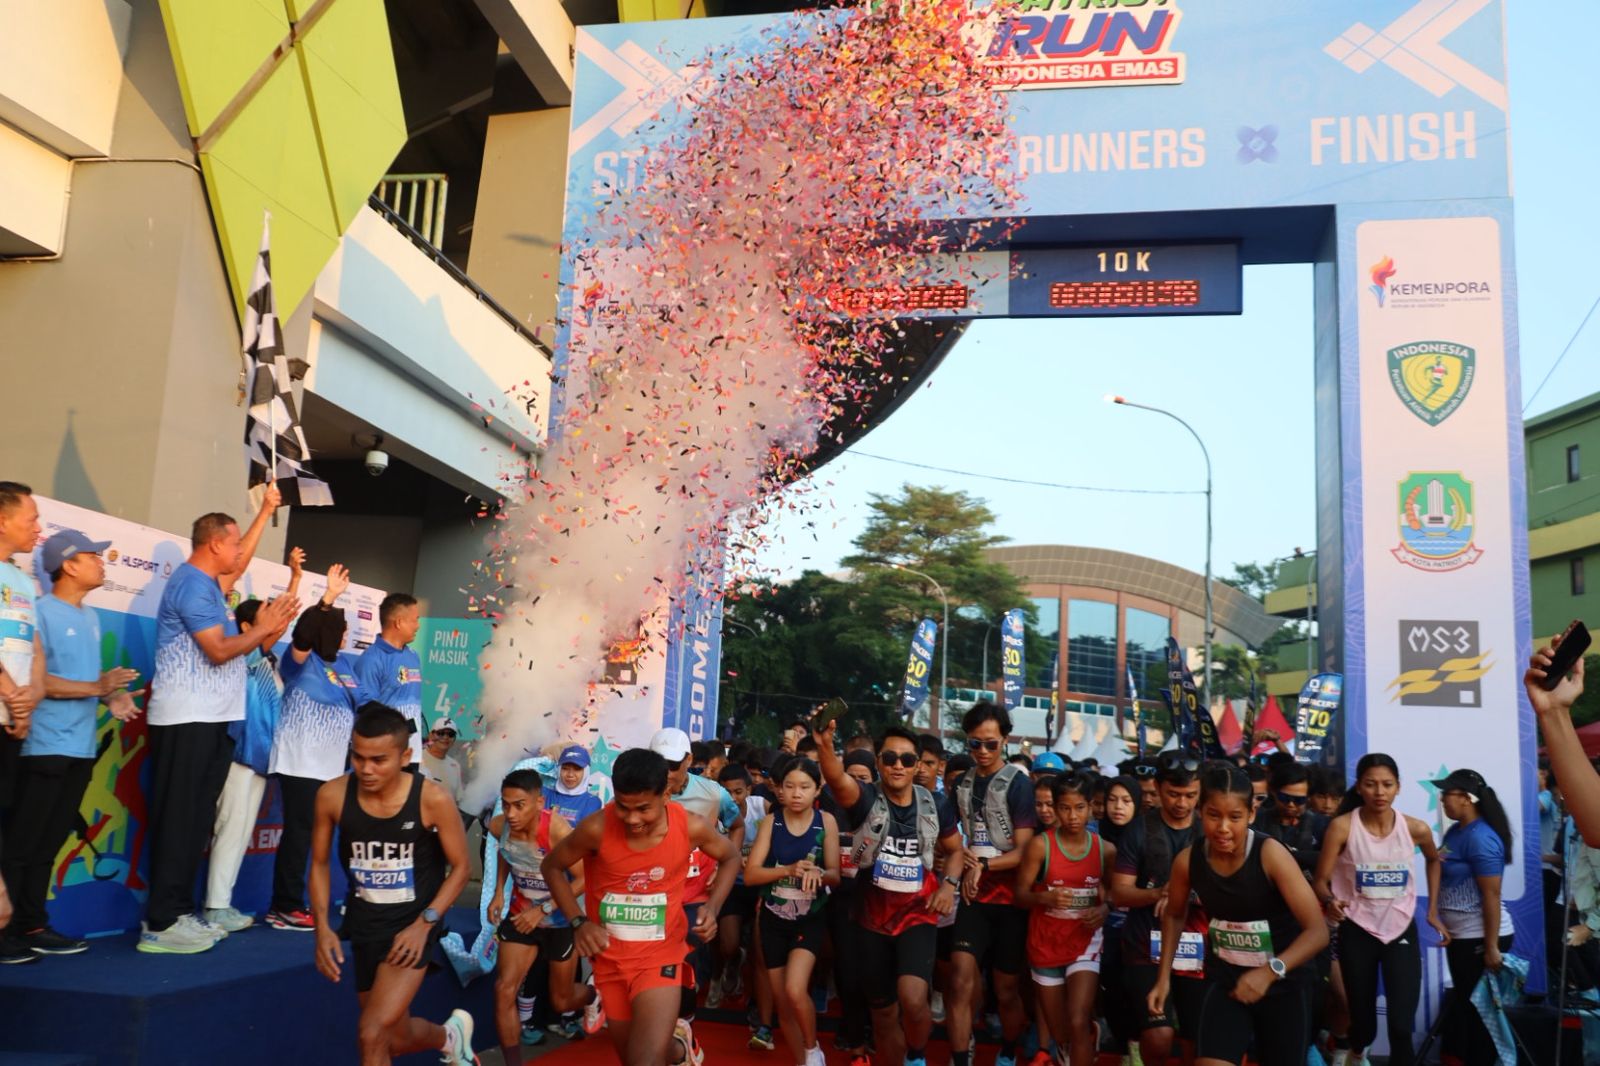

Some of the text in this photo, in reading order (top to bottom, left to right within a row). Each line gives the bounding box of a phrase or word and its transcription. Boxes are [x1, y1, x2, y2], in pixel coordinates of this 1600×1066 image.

[988, 10, 1173, 56] RUN
[1110, 61, 1175, 77] EMAS
[1311, 111, 1476, 166] FINISH
[1018, 127, 1206, 174] RUNNERS
[1390, 282, 1490, 295] KEMENPORA
[1393, 343, 1470, 359] INDONESIA
[433, 630, 468, 648] PINTU
[1408, 626, 1470, 653] MS3
[429, 649, 468, 666] MASUK
[434, 682, 451, 717] 4
[1308, 708, 1330, 728] 70
[351, 841, 414, 861] ACEH
[355, 871, 407, 885] M-12374
[882, 864, 919, 878] PACERS
[606, 906, 657, 920] M-11026
[1216, 932, 1261, 948] F-11043
